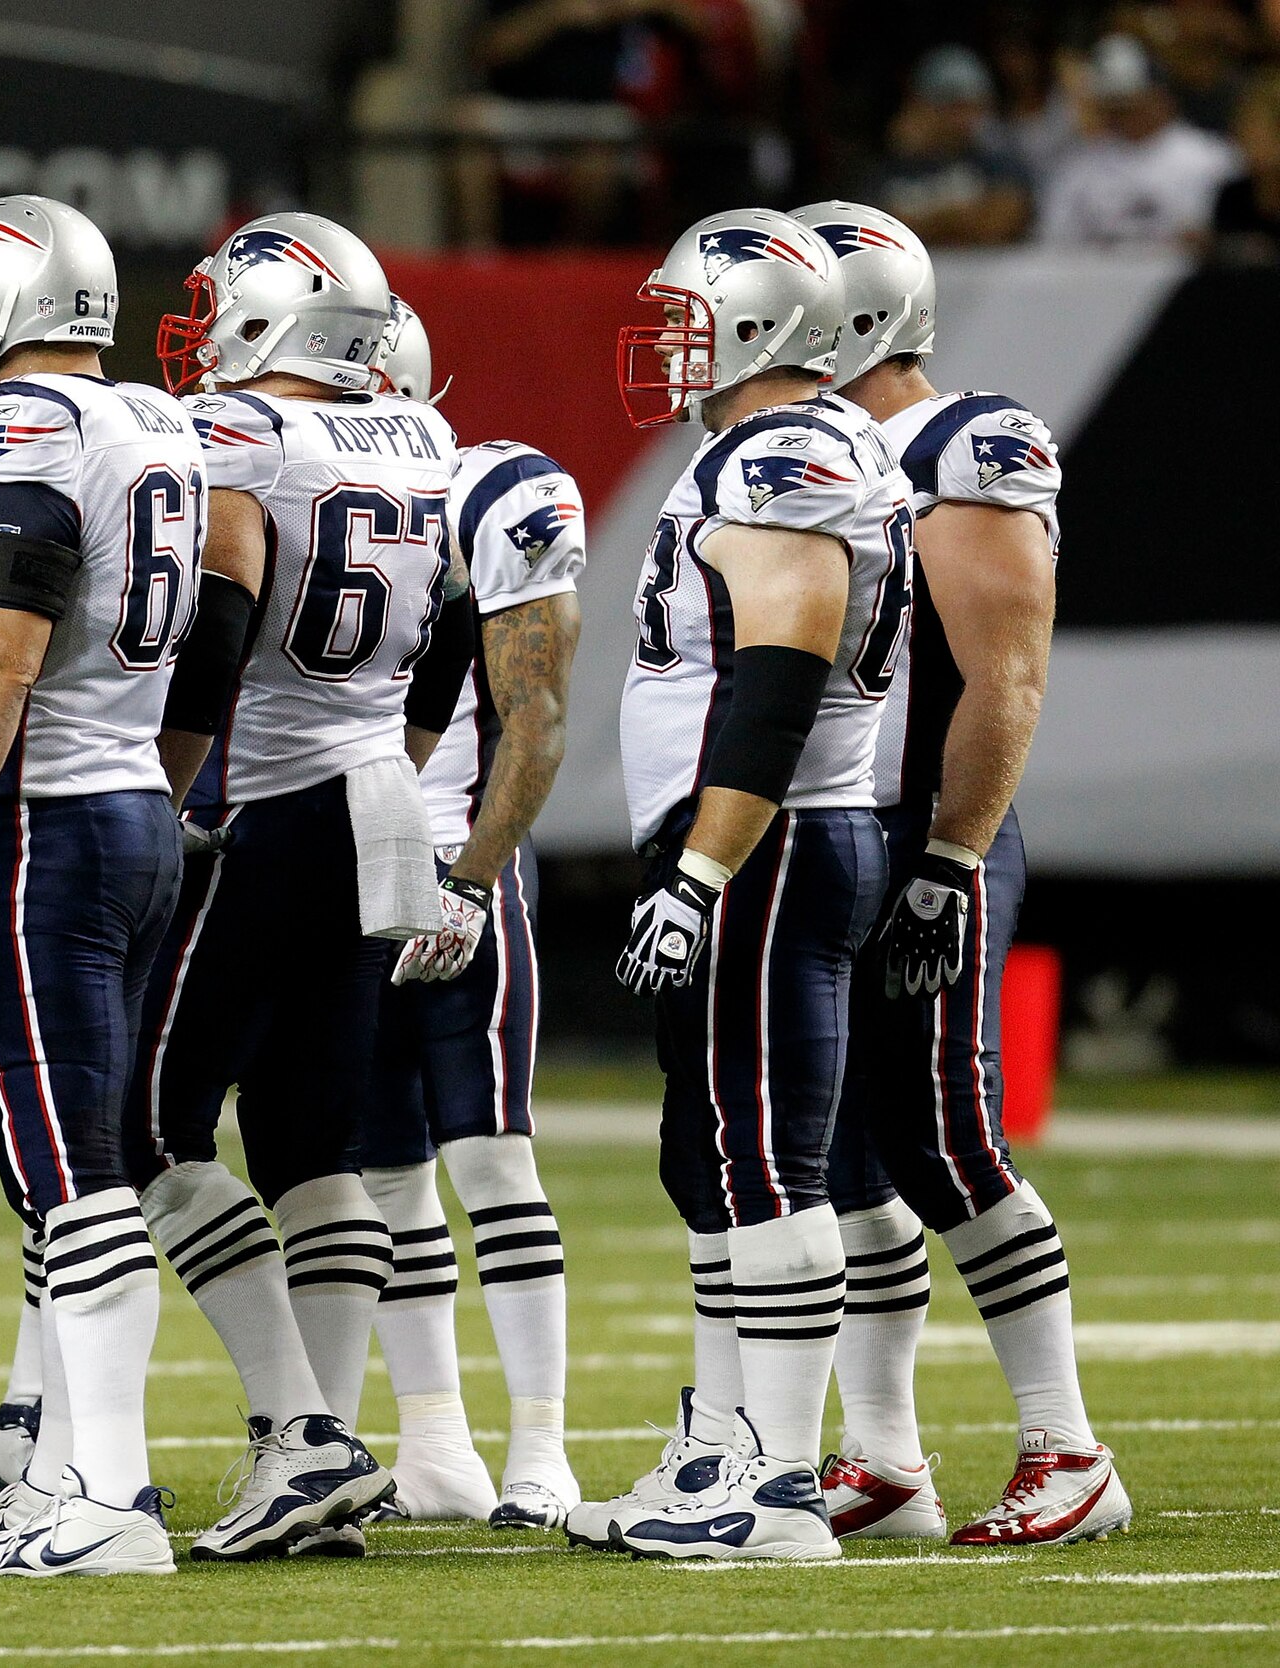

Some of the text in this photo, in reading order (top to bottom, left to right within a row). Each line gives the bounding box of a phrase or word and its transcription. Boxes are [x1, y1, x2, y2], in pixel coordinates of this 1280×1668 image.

[69, 325, 111, 338] PATRIOTS
[312, 411, 441, 461] KOPPEN
[281, 482, 452, 682] 67
